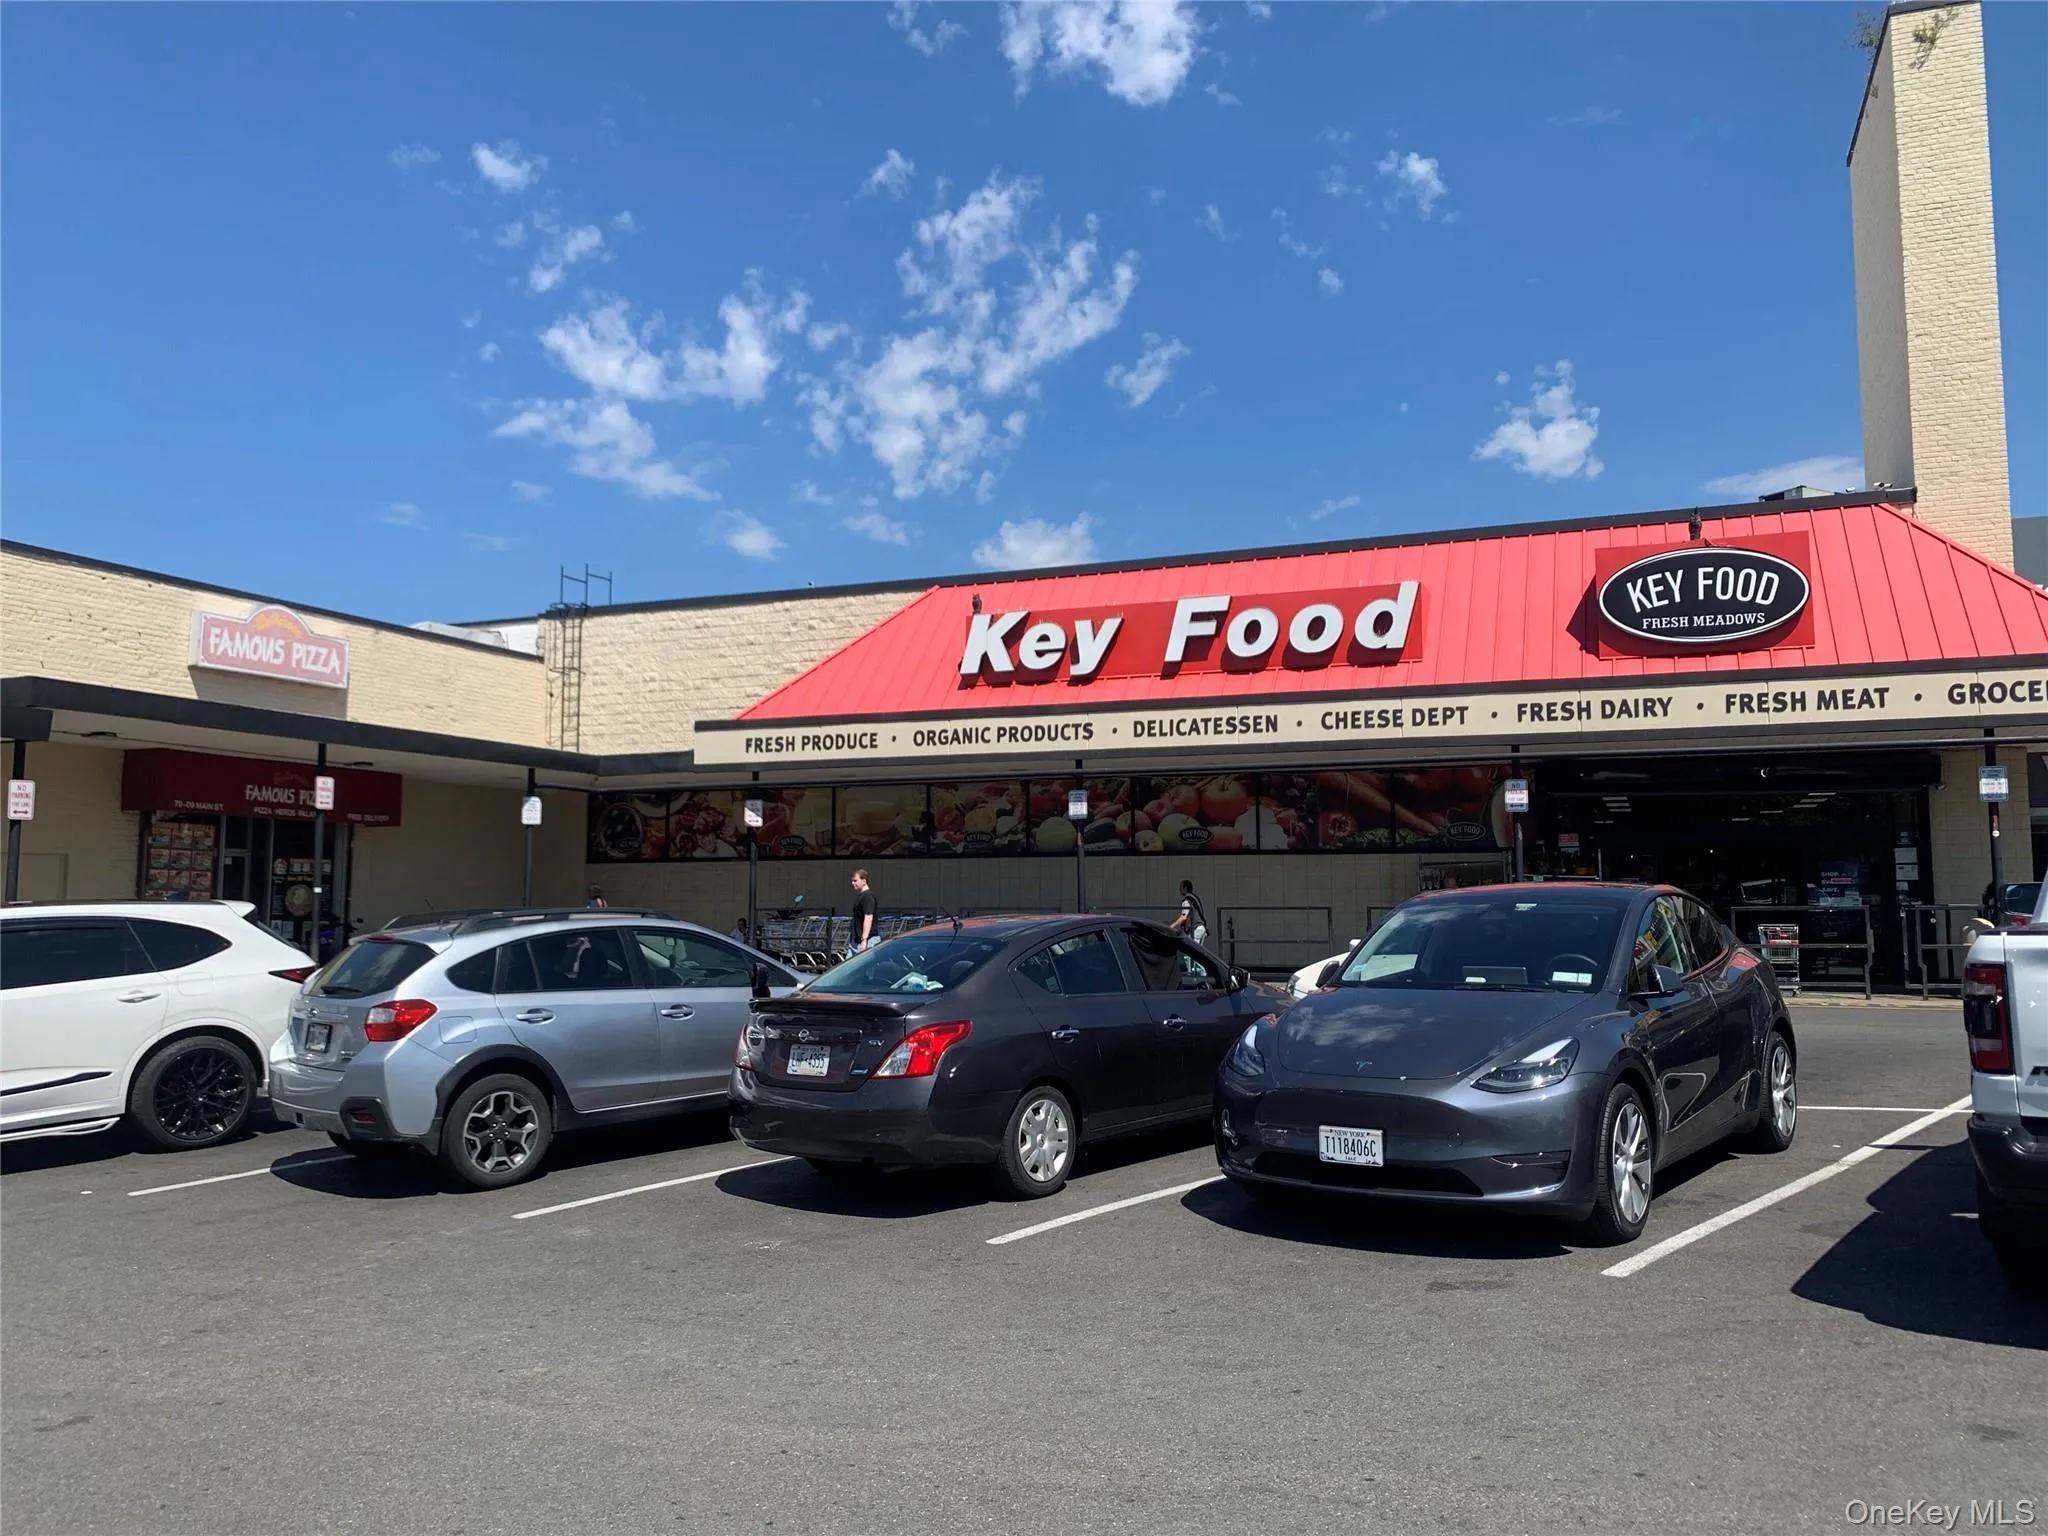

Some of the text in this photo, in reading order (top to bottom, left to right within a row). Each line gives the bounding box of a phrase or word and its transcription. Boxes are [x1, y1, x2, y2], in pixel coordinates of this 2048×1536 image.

[1626, 566, 1780, 613] KEY FOOD
[959, 580, 1421, 677] Key Food
[1641, 611, 1766, 629] FRESH MEADOWS
[208, 626, 341, 675] FAMOUS PIZZA
[744, 680, 2048, 754] FRESH PRODUCE ORGANIC PRODUCTS DELICATESSEN CHEESE DEPT FRESH DAIRY FRESH MEAT GROCE
[245, 784, 317, 806] FAMOUS PIZ
[1450, 825, 1481, 835] KEY FOOD
[868, 1039, 885, 1048] SV
[1334, 1129, 1365, 1138] NEW YORK
[1324, 1136, 1377, 1158] T118406C
